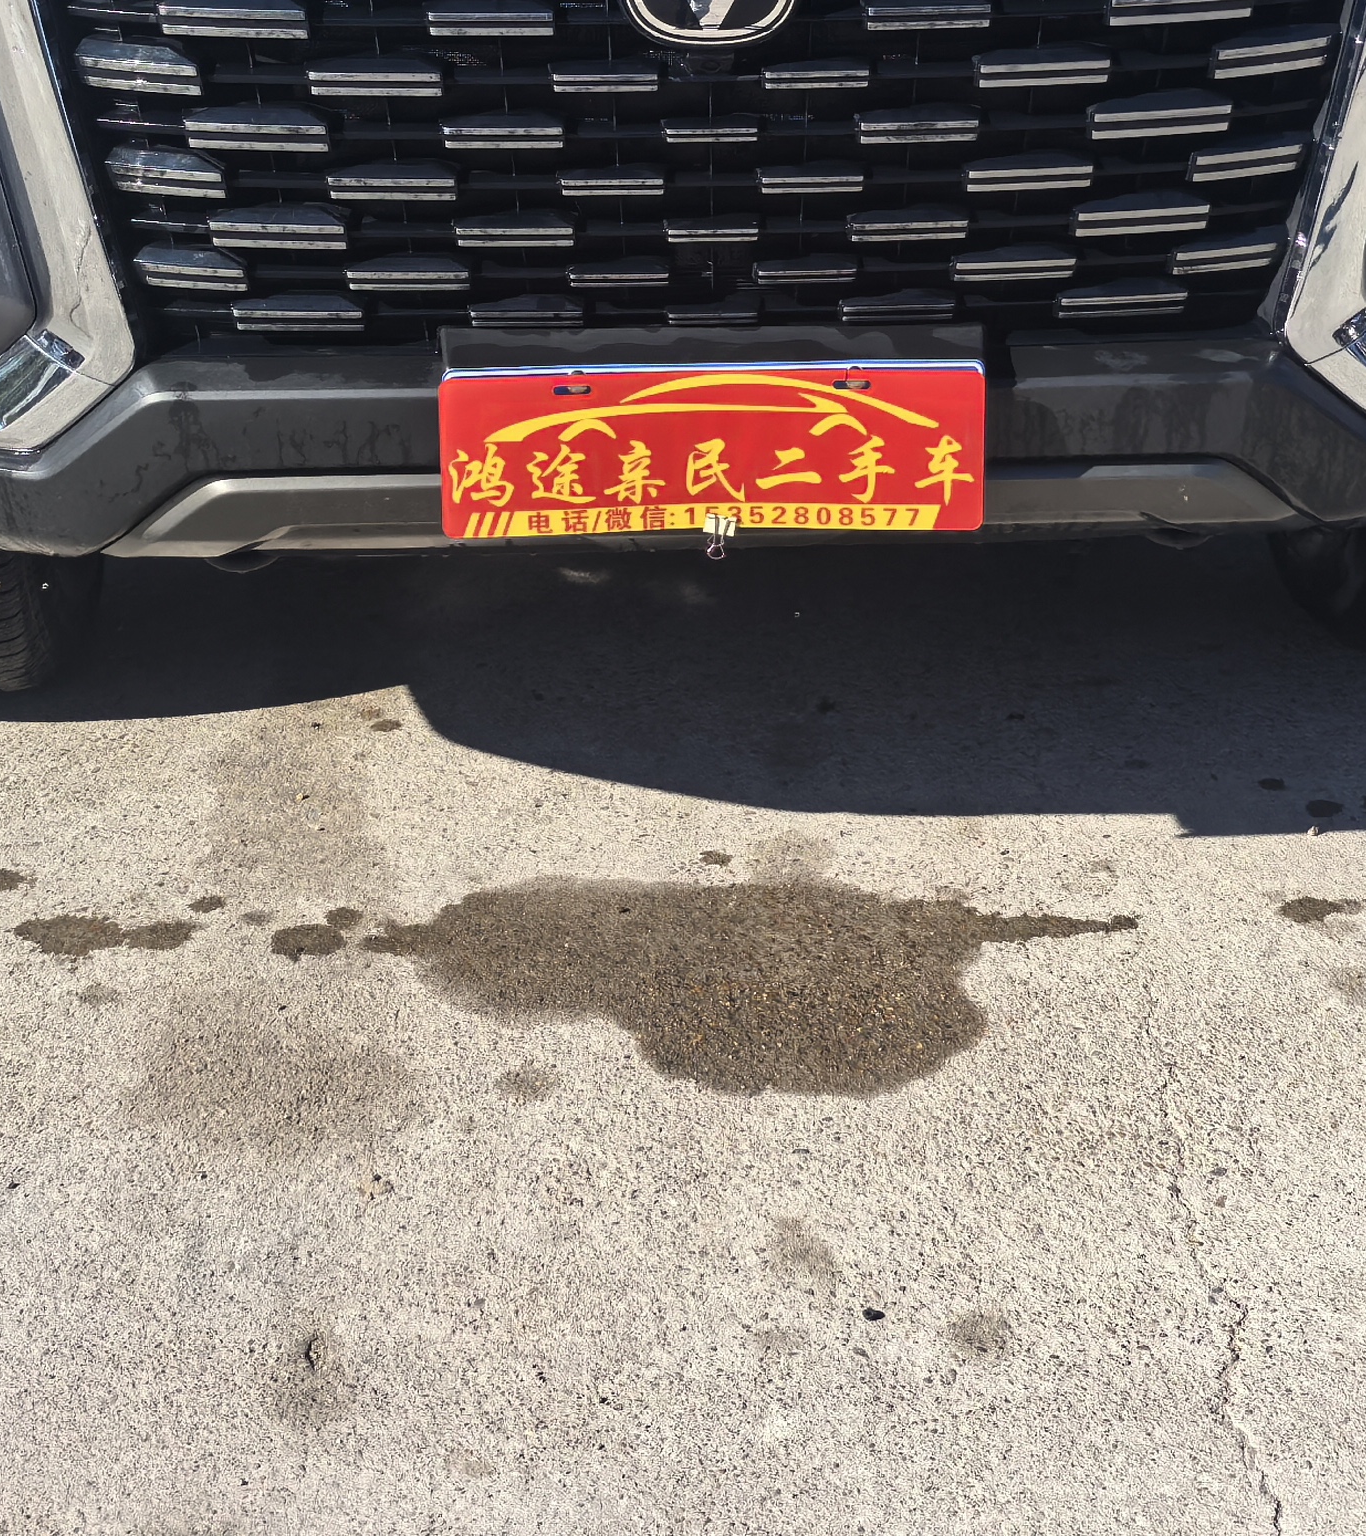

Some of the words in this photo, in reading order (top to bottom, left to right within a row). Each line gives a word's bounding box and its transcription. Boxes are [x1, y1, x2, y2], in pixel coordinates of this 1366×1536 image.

[449, 434, 975, 505] 鸿途亲民二手车
